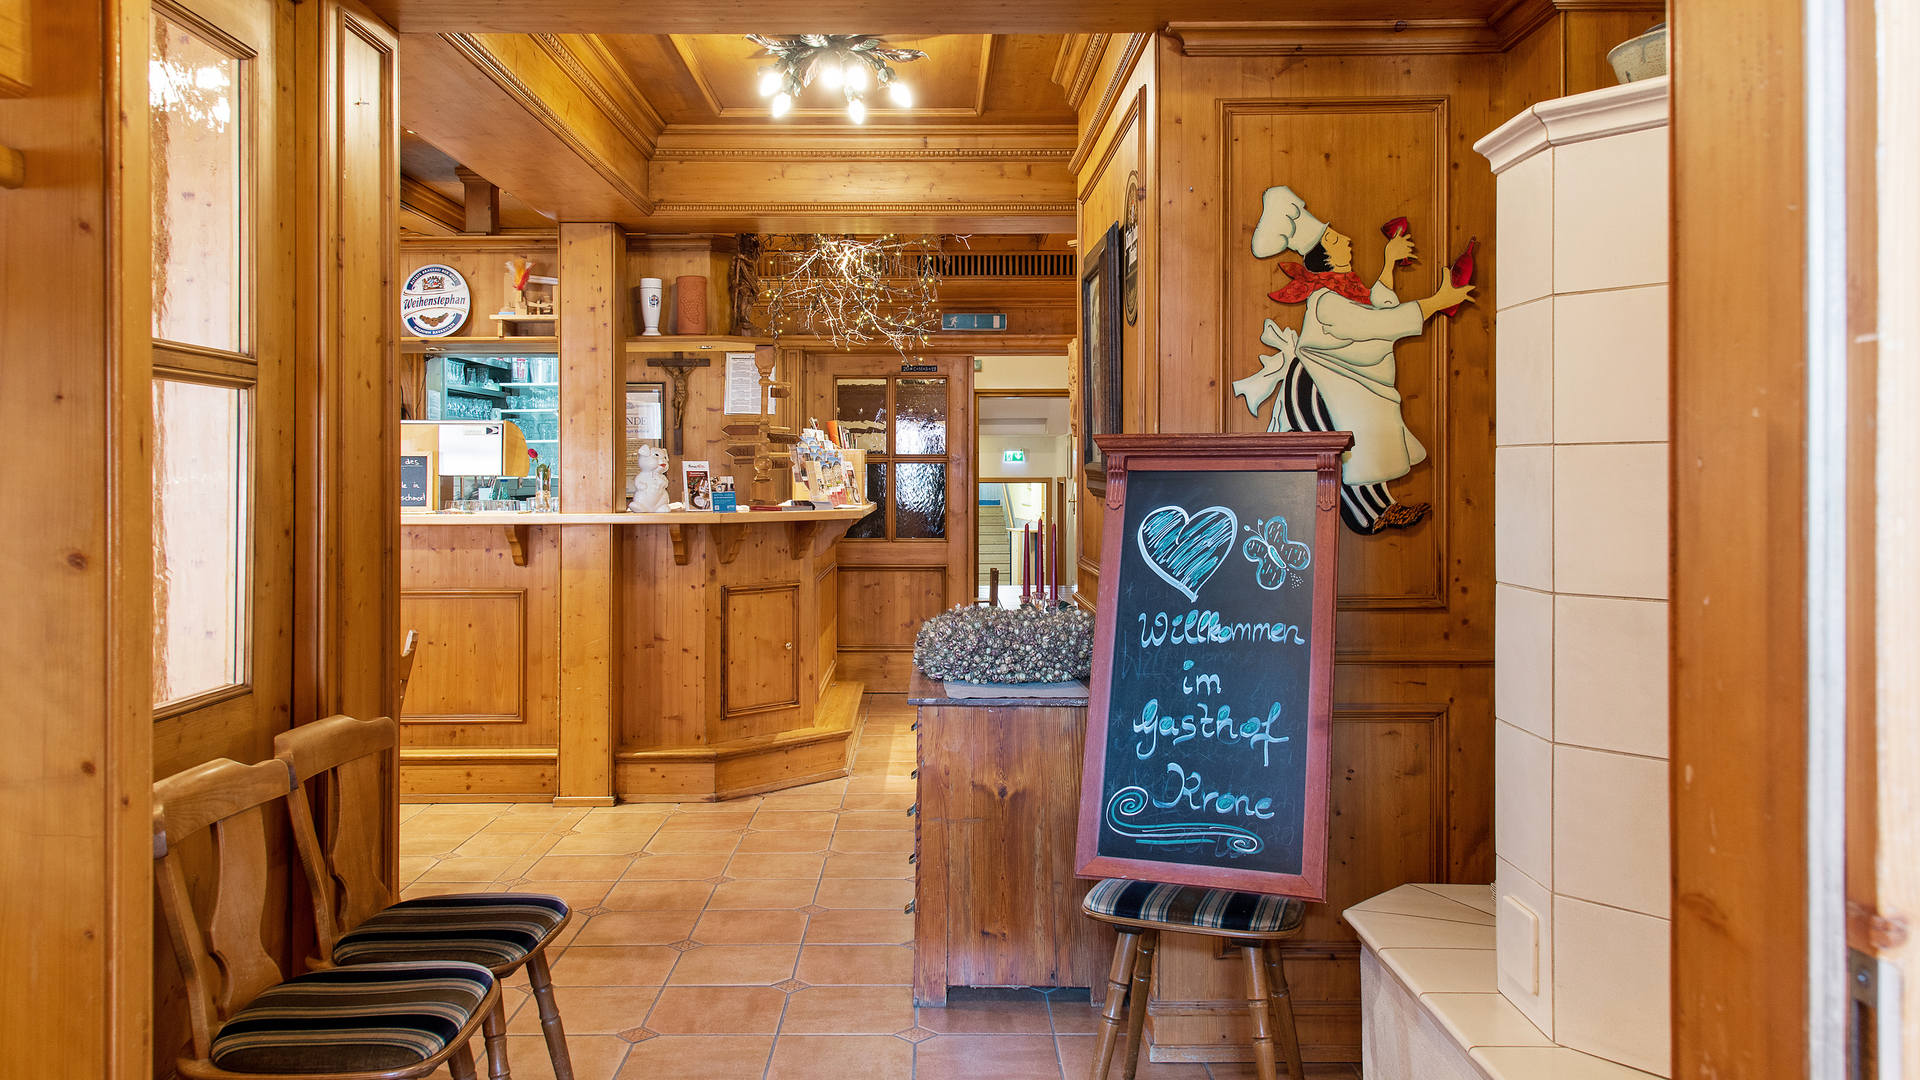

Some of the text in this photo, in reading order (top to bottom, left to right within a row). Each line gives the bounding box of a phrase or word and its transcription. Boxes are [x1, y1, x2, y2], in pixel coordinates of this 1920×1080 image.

[403, 294, 466, 310] Weihenstephan
[1138, 609, 1306, 648] Willkommen
[1183, 659, 1222, 695] im
[1133, 698, 1290, 767] Gasthof
[1153, 762, 1275, 820] Krone
